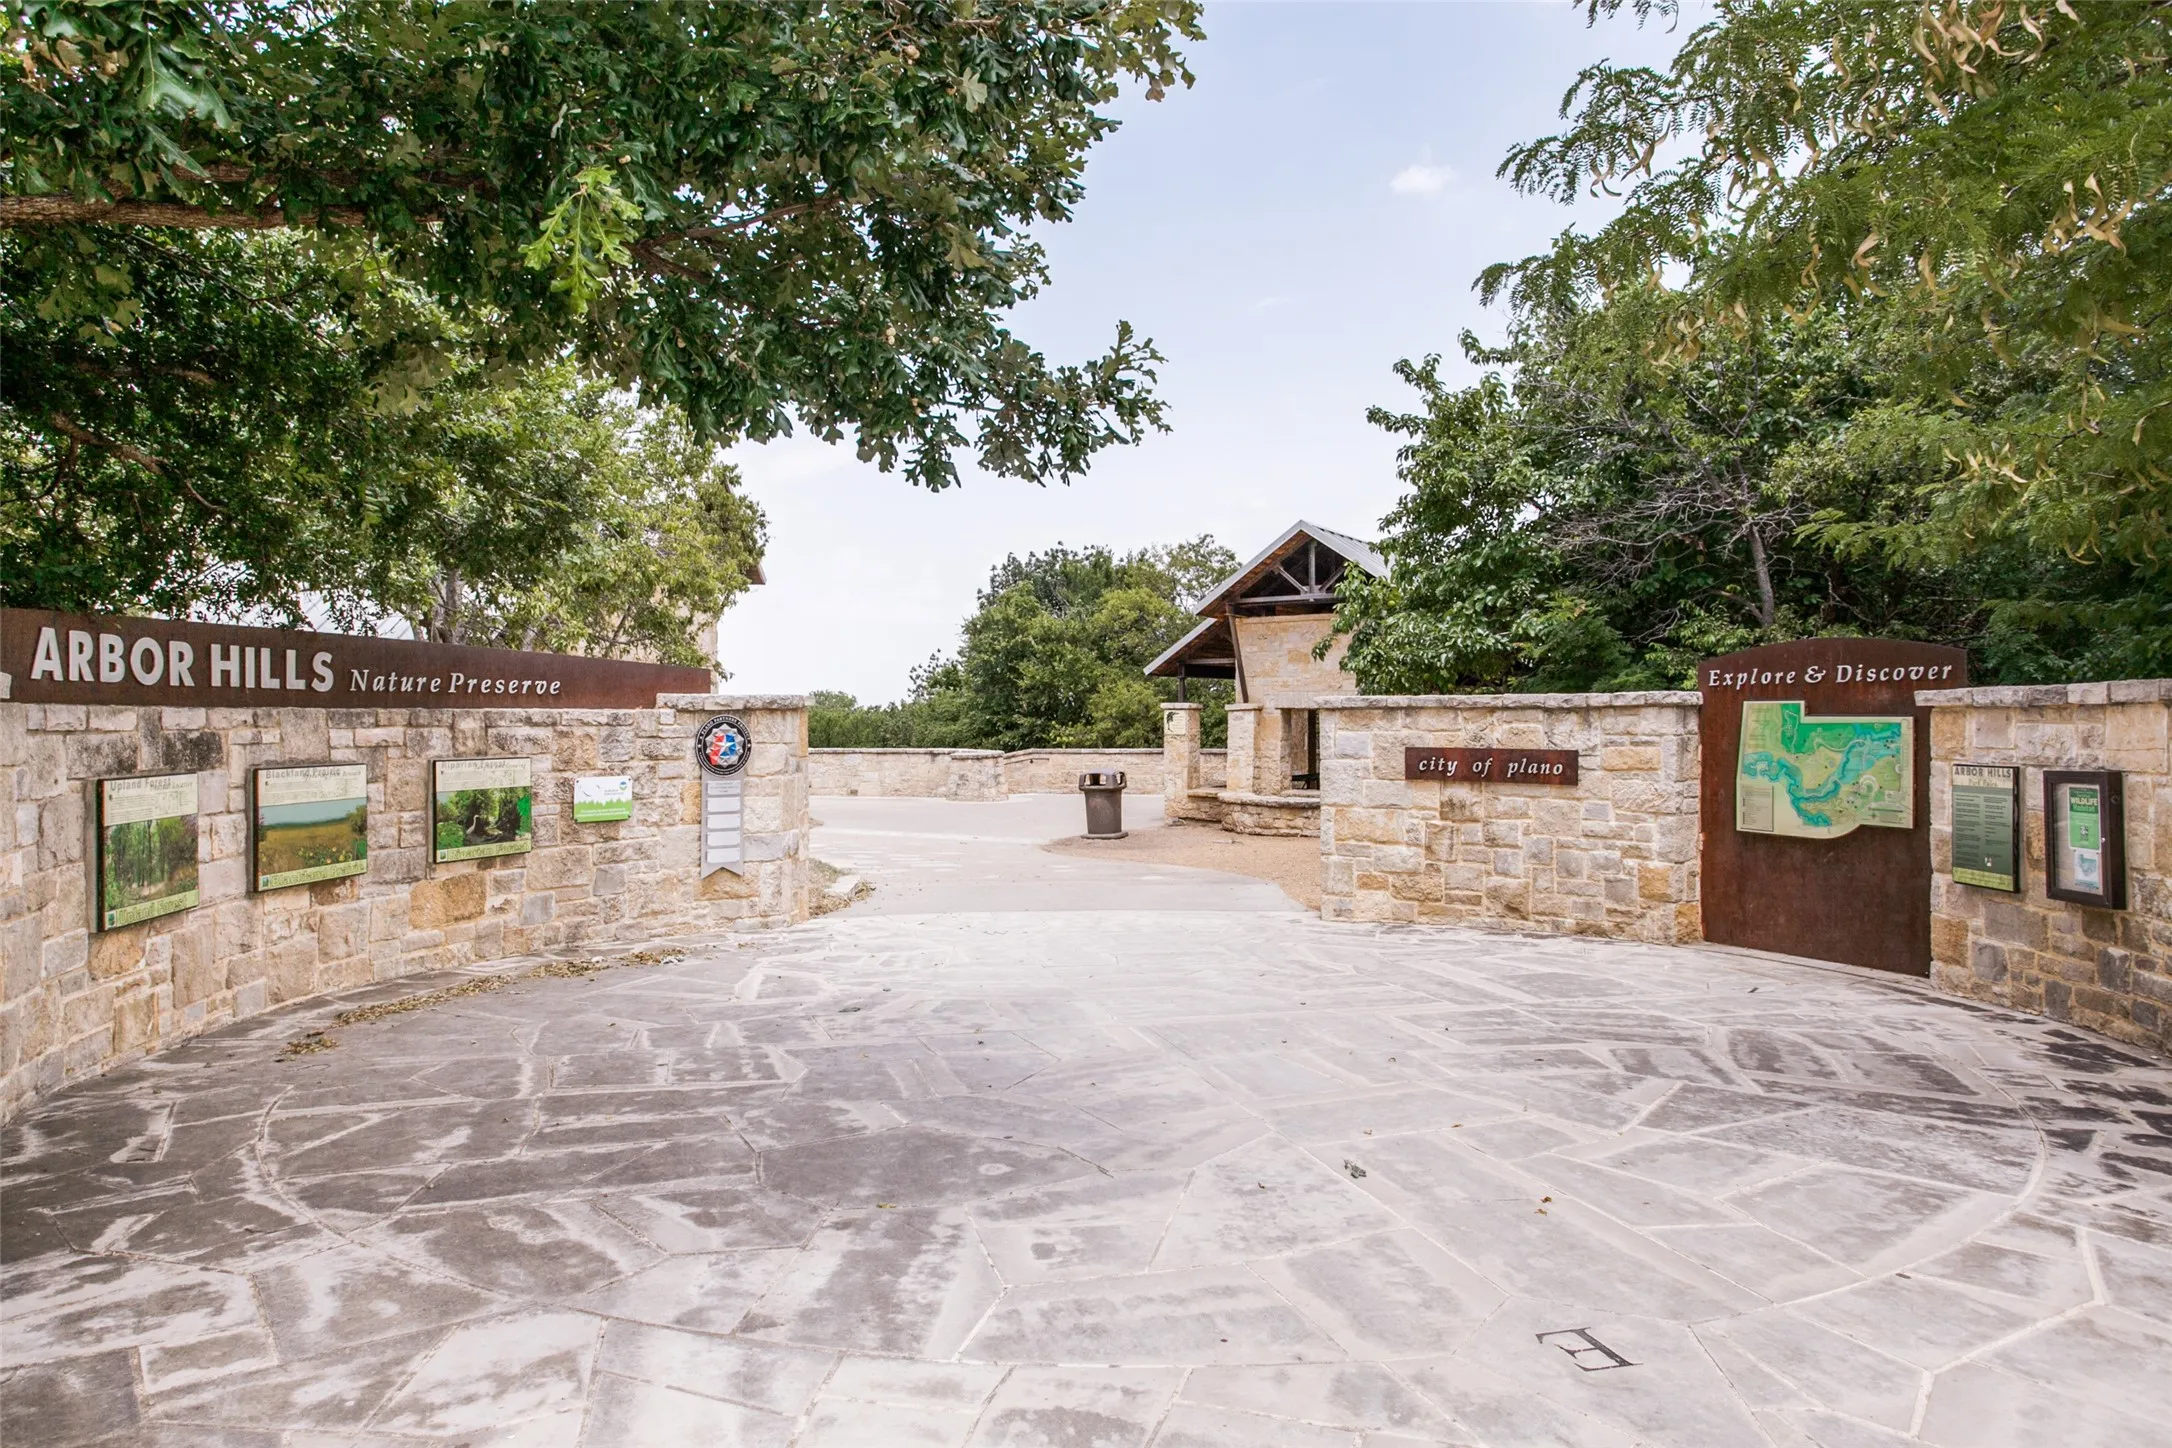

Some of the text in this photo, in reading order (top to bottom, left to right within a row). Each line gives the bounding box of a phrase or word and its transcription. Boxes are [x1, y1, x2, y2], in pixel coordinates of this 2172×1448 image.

[30, 626, 334, 693] ARBOR HILLS
[350, 669, 561, 695] Nature Preserve
[1708, 664, 1952, 690] Explore & Discover
[265, 767, 309, 779] Blackland
[1419, 757, 1563, 778] city of plano
[1954, 766, 2011, 778] ARBOR HILLS
[110, 780, 142, 793] Upland
[145, 778, 171, 790] Forest
[2070, 797, 2099, 806] WILDLIFE
